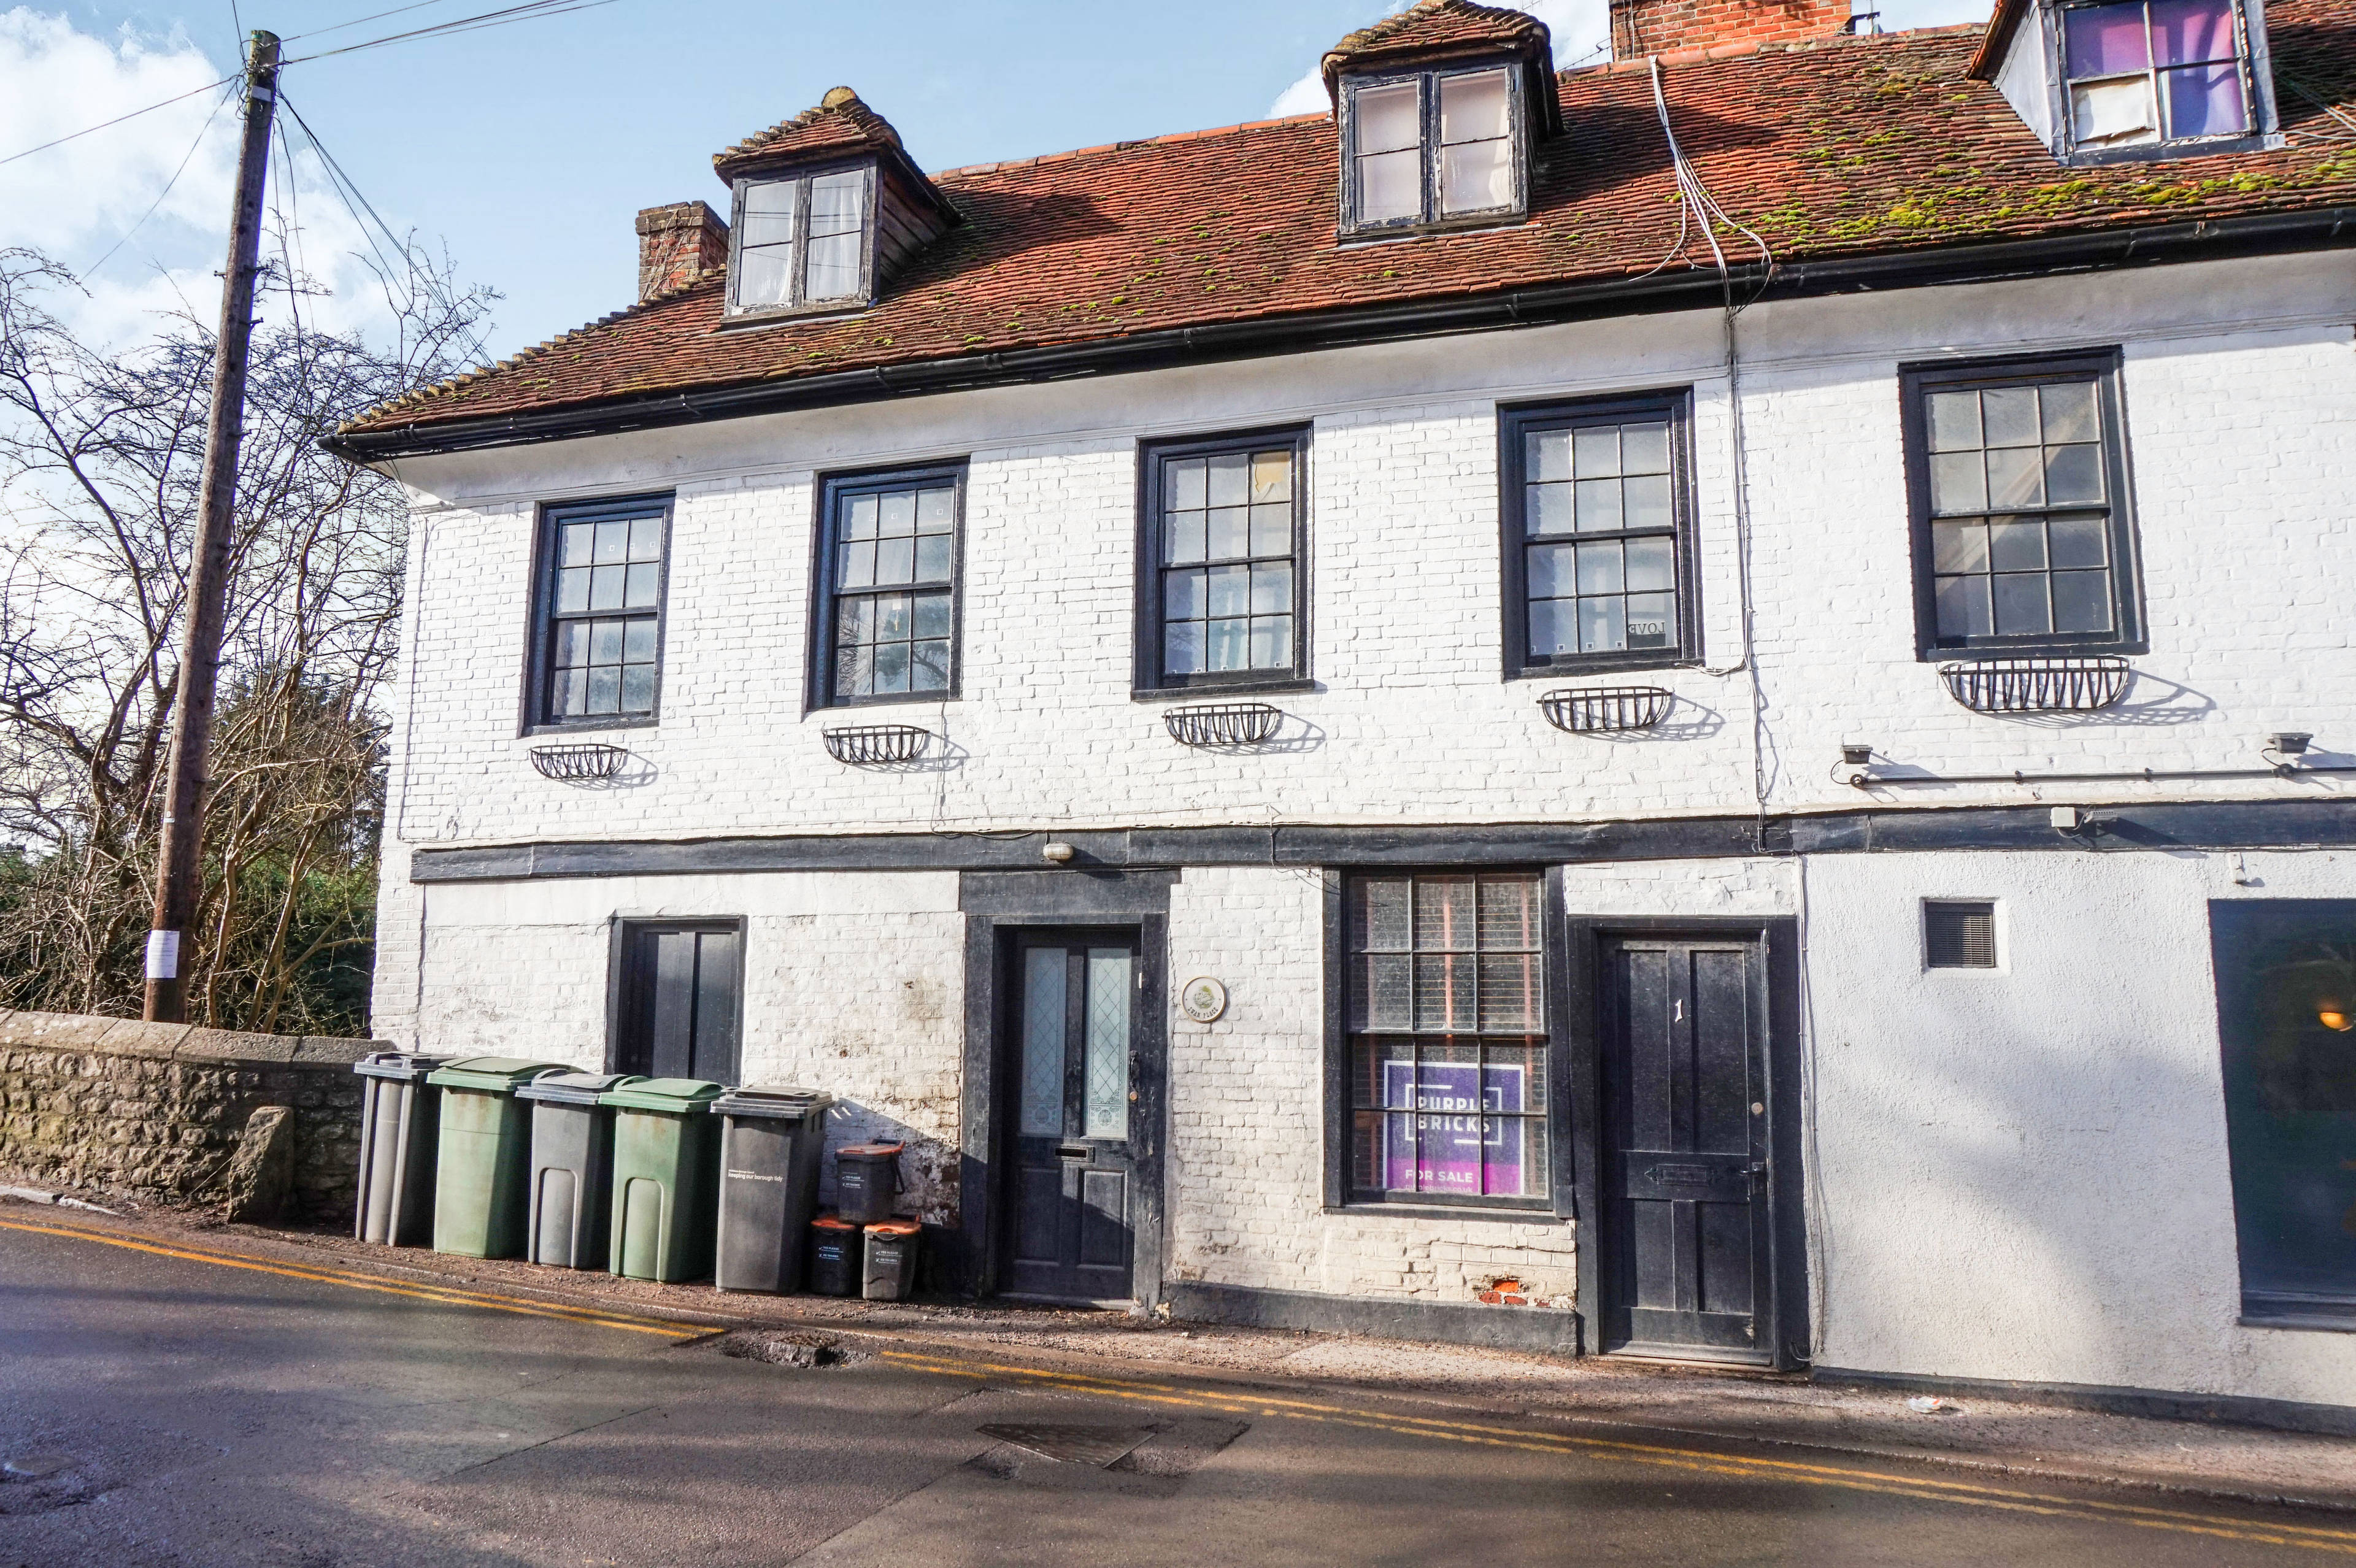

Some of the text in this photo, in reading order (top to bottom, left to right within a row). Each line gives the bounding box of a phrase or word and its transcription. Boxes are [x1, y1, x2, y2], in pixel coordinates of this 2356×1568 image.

[1188, 1007, 1218, 1018] SWAN PLACE
[1675, 999, 1683, 1022] 1
[1418, 1096, 1490, 1111] PURPLE
[1418, 1115, 1490, 1132] BRICKS
[1438, 1171, 1473, 1183] SALE
